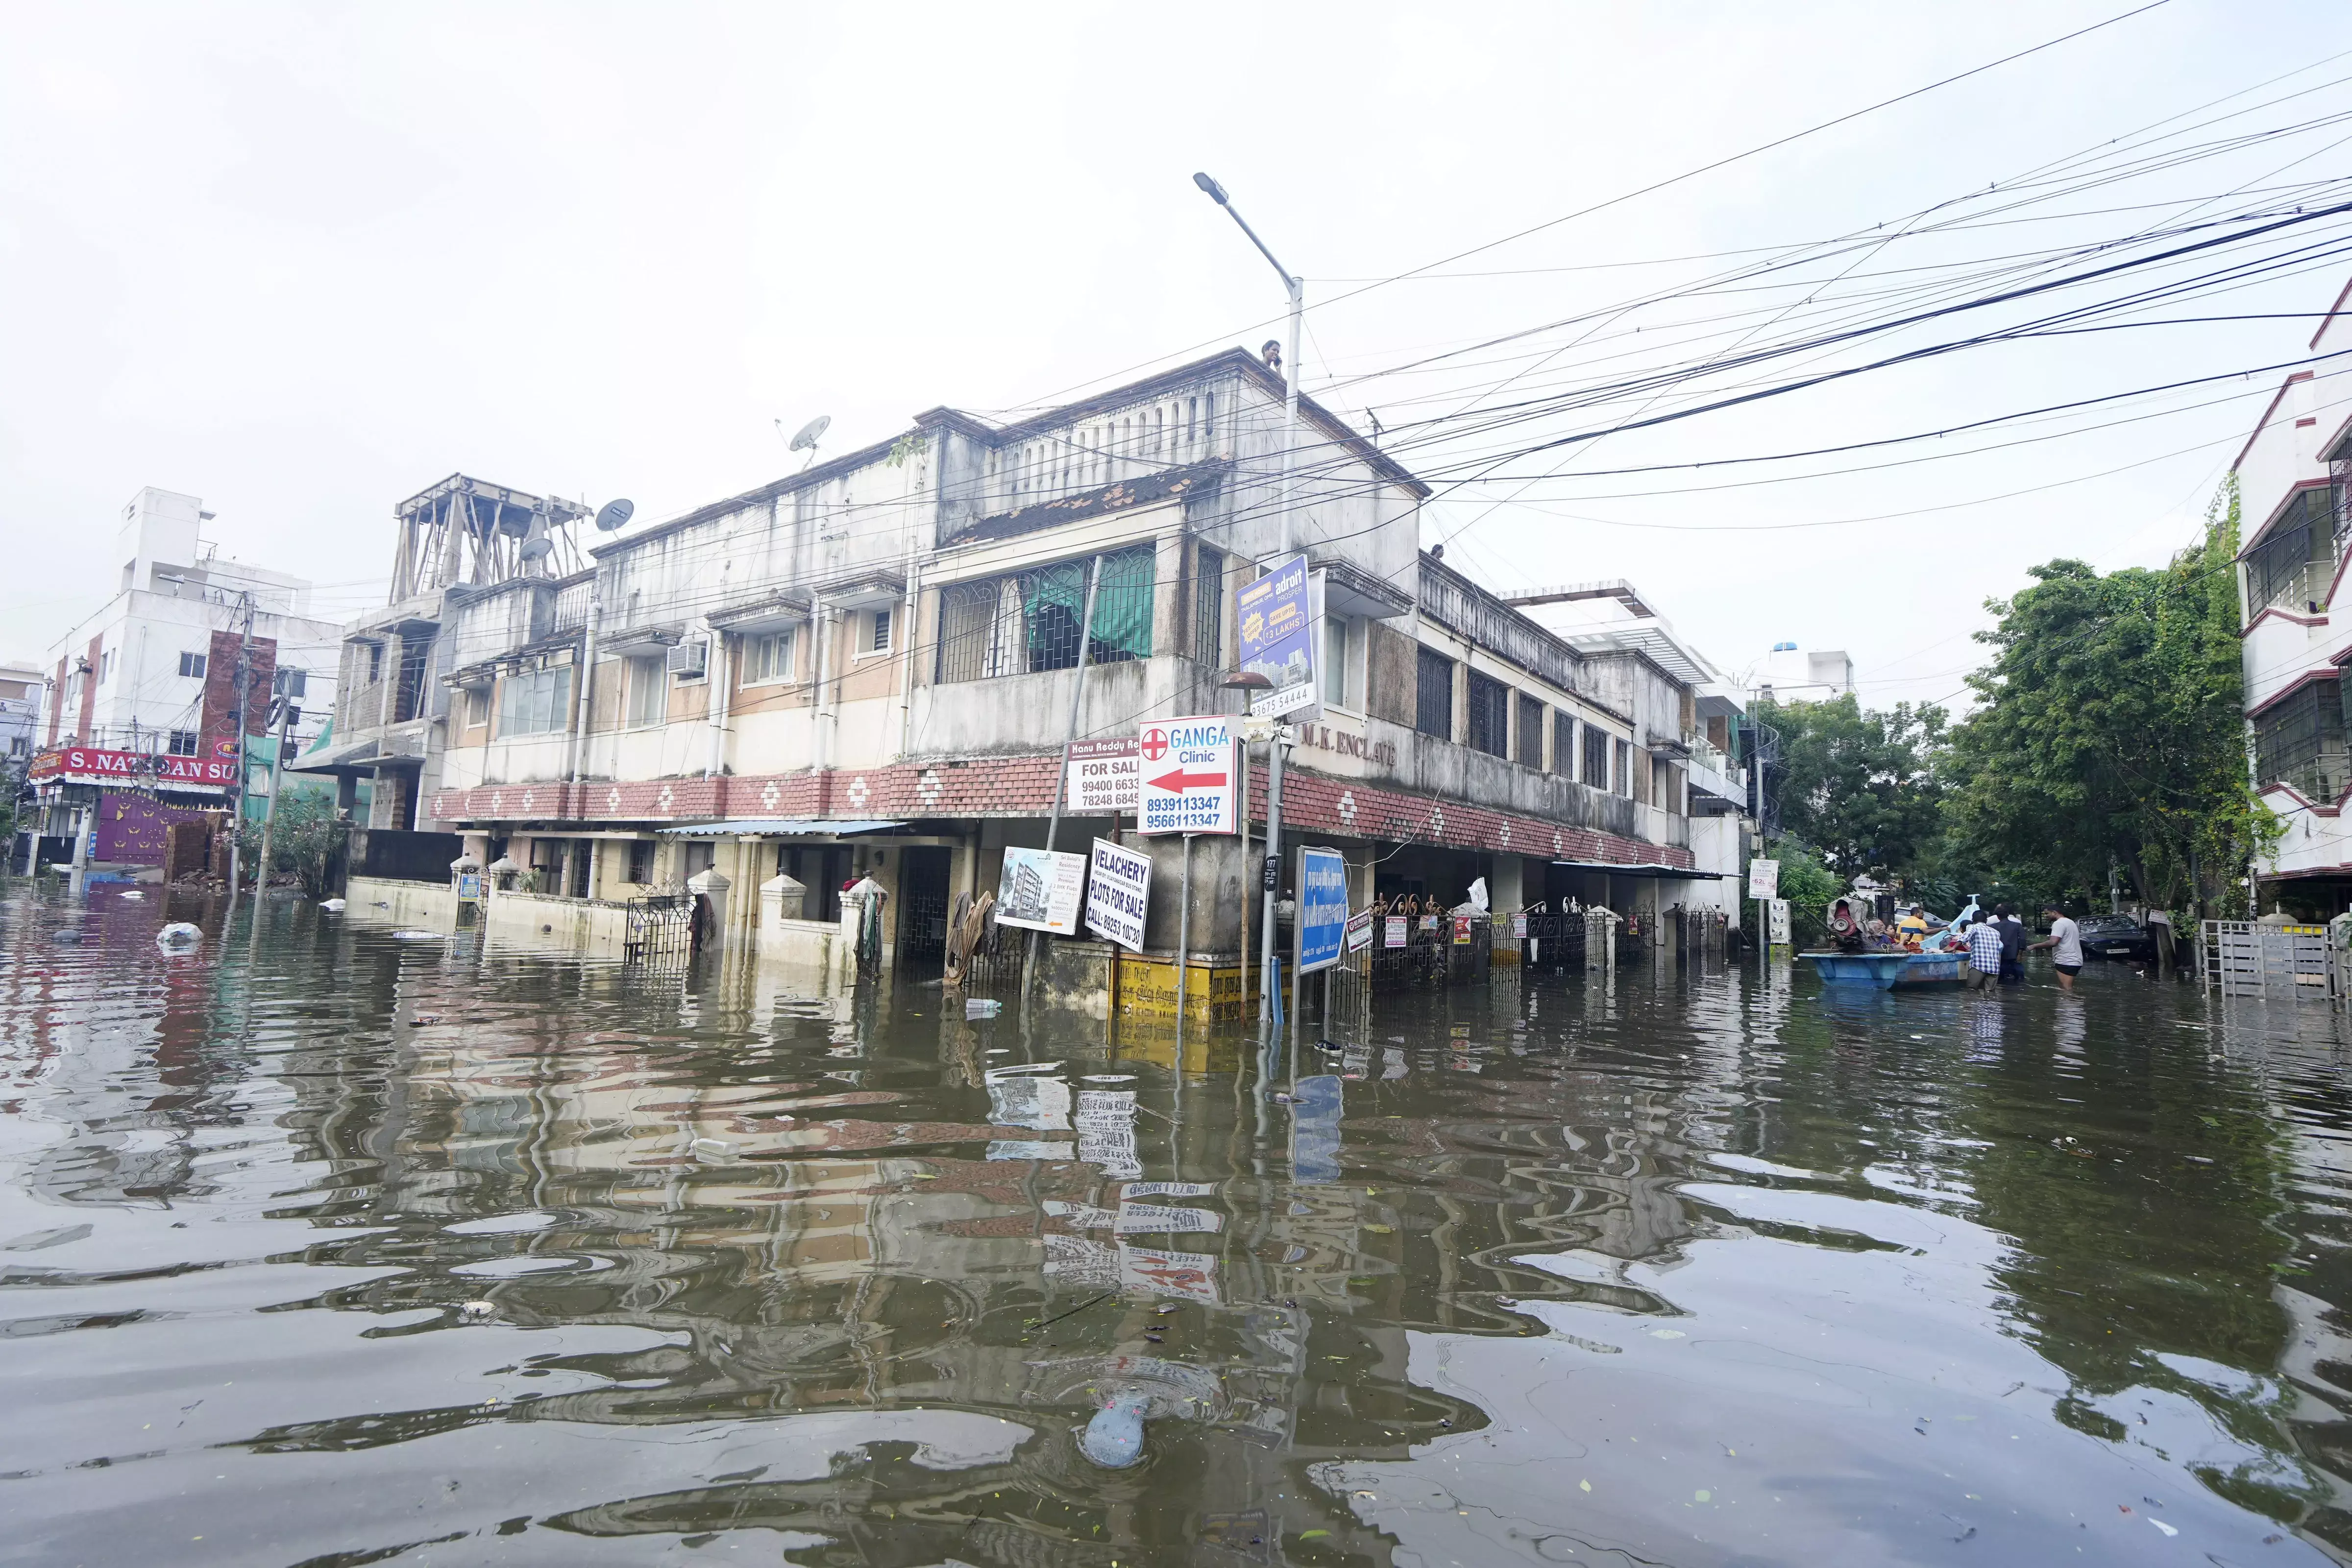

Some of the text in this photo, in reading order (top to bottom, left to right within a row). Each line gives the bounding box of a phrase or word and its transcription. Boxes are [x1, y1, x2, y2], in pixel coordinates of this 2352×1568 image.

[1275, 568, 1302, 595] adroit
[1264, 592, 1274, 601] OMR
[1277, 585, 1302, 603] PROSPER
[1270, 612, 1281, 622] SAVE
[1244, 617, 1261, 634] FESTIVAL
[1247, 625, 1260, 638] OFFER
[1252, 700, 1275, 717] 93675
[1279, 688, 1307, 707] 54444
[1171, 726, 1229, 748] GANGA
[1072, 744, 1094, 753] Hanu
[1096, 741, 1125, 751] Reddy
[1179, 750, 1215, 764] Clinic
[1082, 763, 1108, 776] FOR
[1082, 780, 1112, 792] 99400
[1082, 795, 1112, 806] 78248
[1147, 796, 1220, 812] 8939113347
[1147, 814, 1220, 828] 9566113347
[1095, 848, 1147, 884] VELACHERY
[1267, 859, 1276, 868] 177
[1132, 883, 1143, 894] STAND)
[1090, 879, 1144, 920] PLOTS FOR SALE
[1087, 906, 1102, 927] CALL:
[1103, 914, 1121, 936] 89253
[1357, 915, 1369, 925] PARKING
